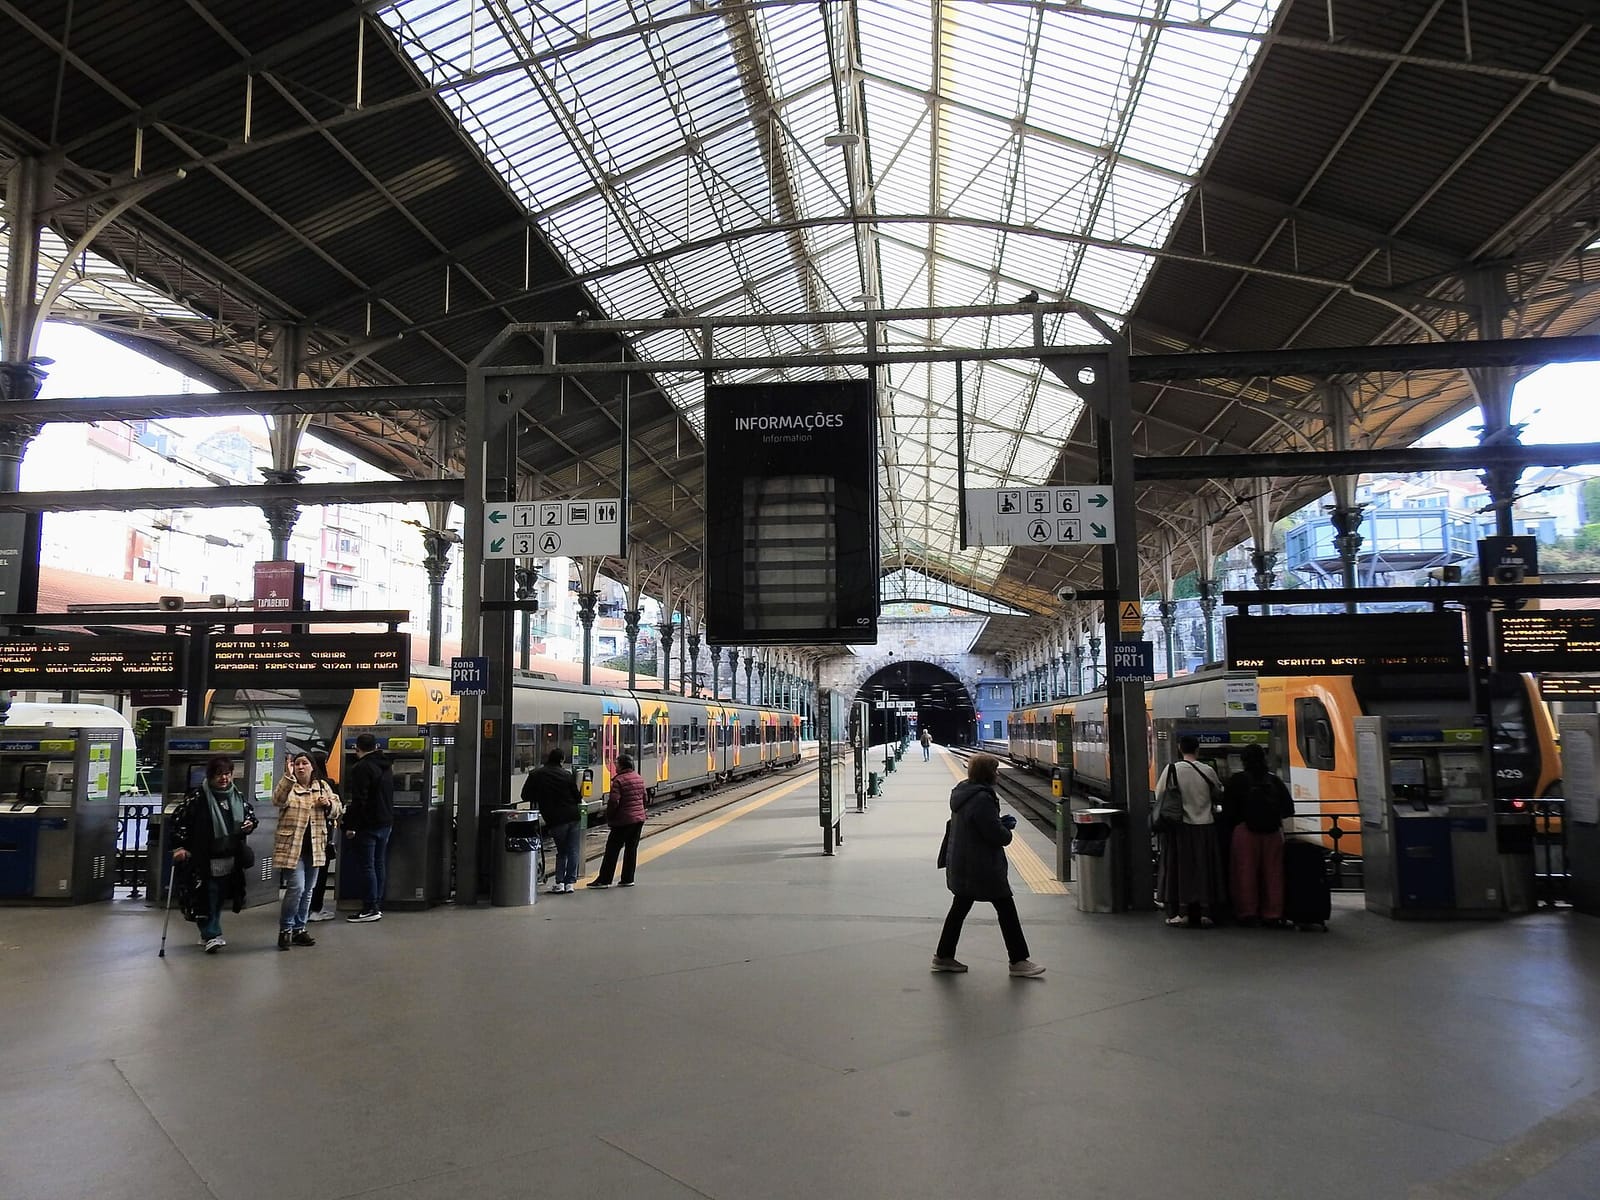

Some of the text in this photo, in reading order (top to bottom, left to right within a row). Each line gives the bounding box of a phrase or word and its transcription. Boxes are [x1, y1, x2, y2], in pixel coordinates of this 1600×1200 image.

[736, 412, 844, 431] INFORMAÇÕES
[763, 434, 813, 443] Information
[1034, 498, 1073, 512] 5 6
[521, 511, 556, 526] 1 2
[1033, 525, 1074, 540] A 4
[520, 537, 556, 553] 3 A
[1114, 645, 1137, 653] zona
[1114, 653, 1145, 667] PRT1
[453, 669, 480, 681] PRT1
[1115, 674, 1152, 682] andante
[453, 687, 486, 696] andante
[1496, 769, 1524, 779] 429
